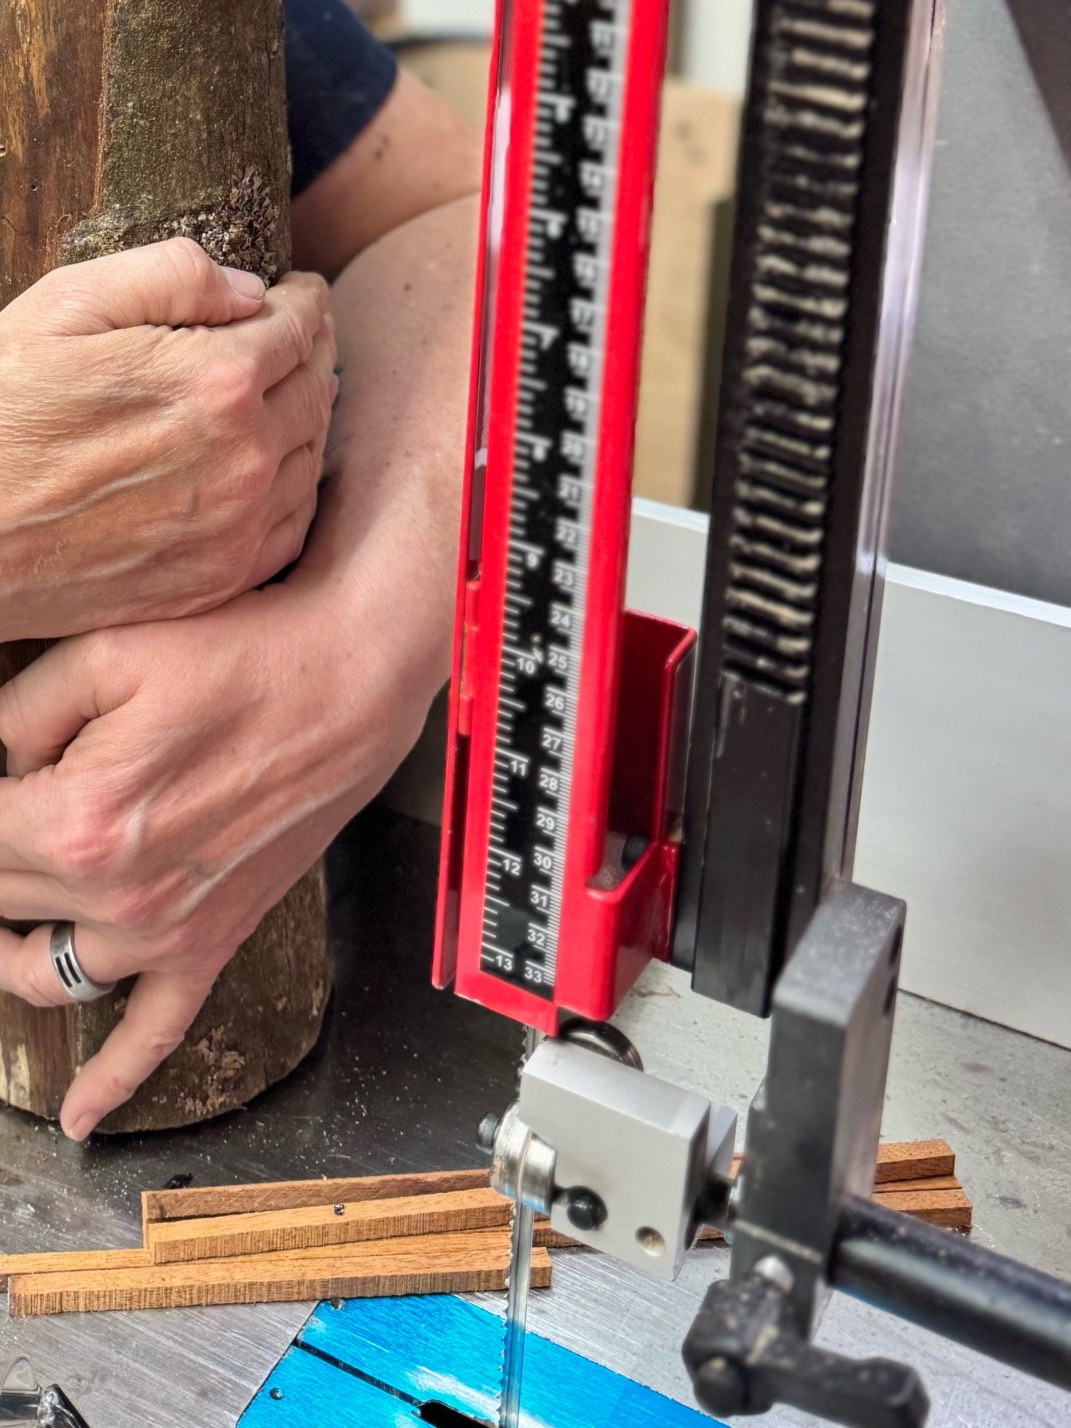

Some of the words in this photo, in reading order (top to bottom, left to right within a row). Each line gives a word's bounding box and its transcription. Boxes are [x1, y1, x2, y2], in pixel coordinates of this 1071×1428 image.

[559, 482, 578, 499] 21
[555, 526, 577, 545] 22
[527, 552, 539, 568] 9
[554, 568, 574, 586] 23
[550, 609, 570, 627] 24
[516, 657, 536, 675] 10
[548, 652, 568, 670] 25
[545, 693, 565, 711] 26
[542, 733, 562, 751] 27
[510, 759, 527, 777] 11
[539, 773, 559, 792] 28
[536, 813, 556, 831] 29
[502, 858, 521, 877] 12
[533, 852, 553, 870] 30
[530, 890, 548, 908] 31
[527, 928, 546, 947] 32
[495, 954, 514, 972] 13
[524, 966, 543, 984] 33
